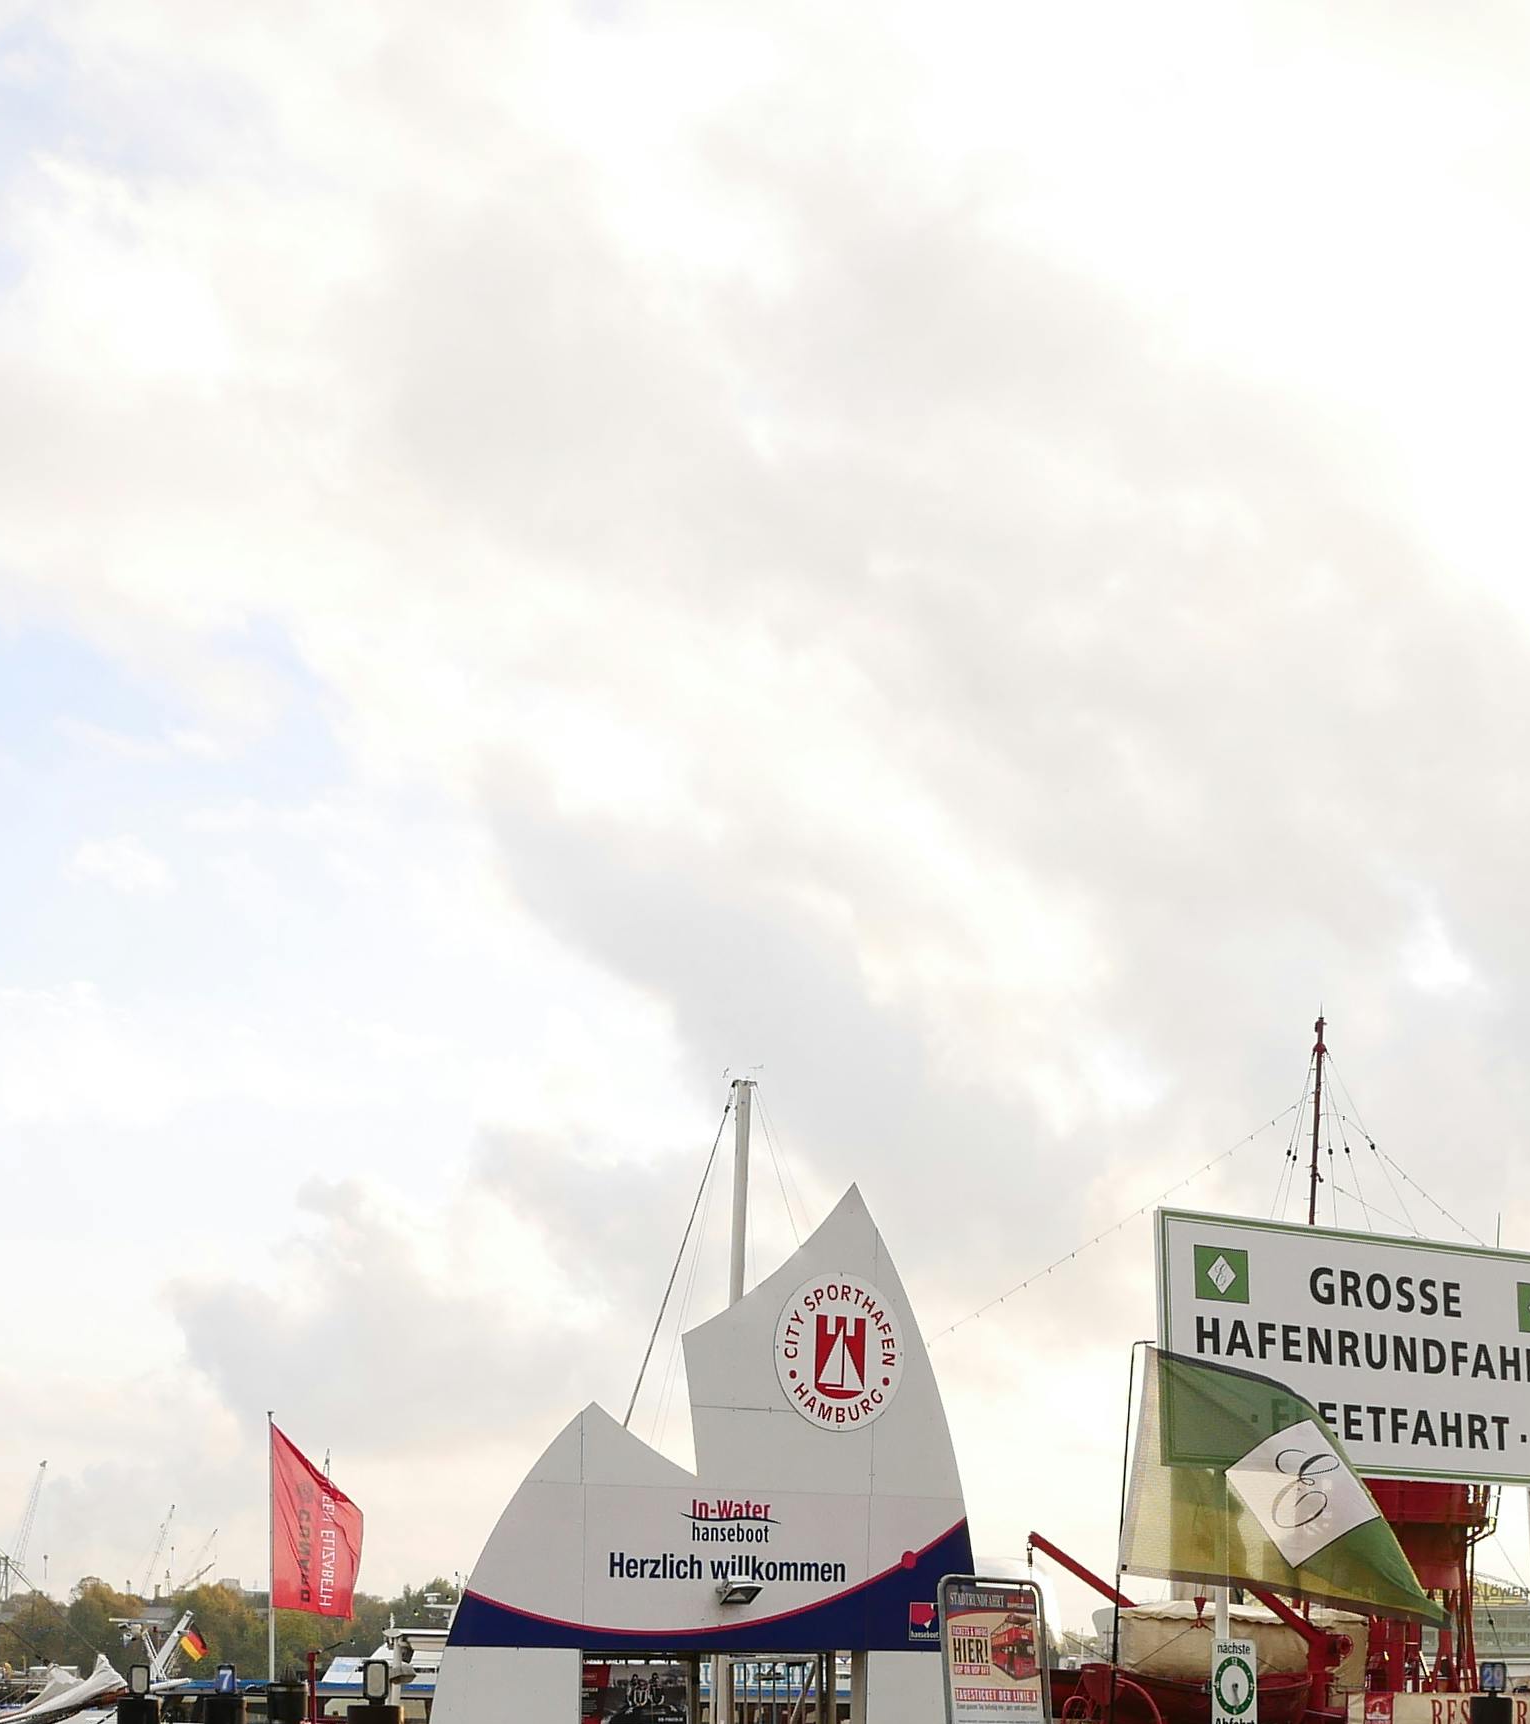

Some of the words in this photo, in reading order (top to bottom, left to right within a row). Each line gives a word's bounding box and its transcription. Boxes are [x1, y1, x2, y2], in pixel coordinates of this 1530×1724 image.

[1309, 1266, 1462, 1318] GROSSE
[784, 1309, 805, 1359] CITY
[804, 1284, 896, 1367] SPORTHAFEN
[793, 1382, 884, 1423] HAMBURG
[692, 1499, 770, 1520] In-Water
[691, 1521, 770, 1543] hanseboot
[608, 1552, 703, 1580] Herzlich
[710, 1554, 847, 1583] willkommen
[952, 1637, 989, 1664] HIER!
[1216, 1642, 1251, 1655] nächste
[219, 1669, 232, 1690] 7
